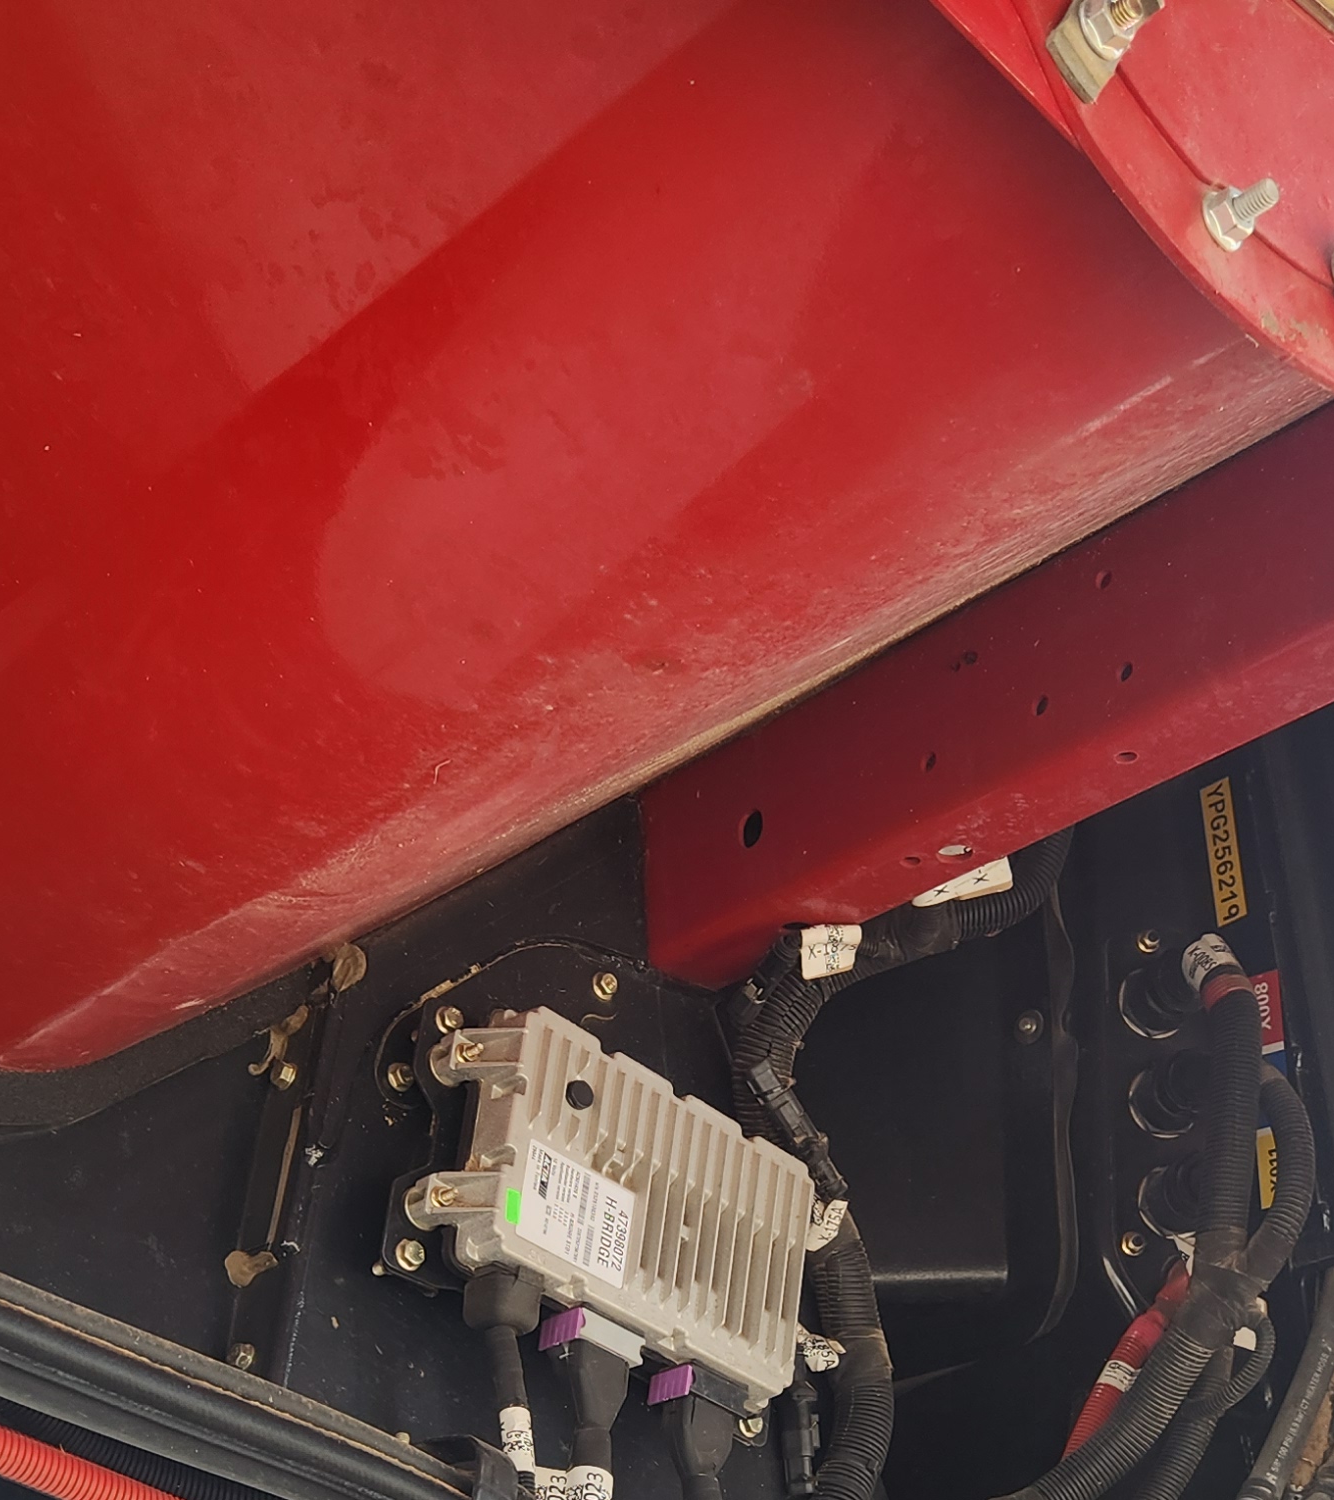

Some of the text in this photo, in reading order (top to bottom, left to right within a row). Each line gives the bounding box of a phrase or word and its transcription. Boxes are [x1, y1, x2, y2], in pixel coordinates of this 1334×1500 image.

[1207, 782, 1240, 921] YPG256219
[597, 1196, 618, 1268] H-BRIDGE
[611, 1210, 629, 1272] 47398072
